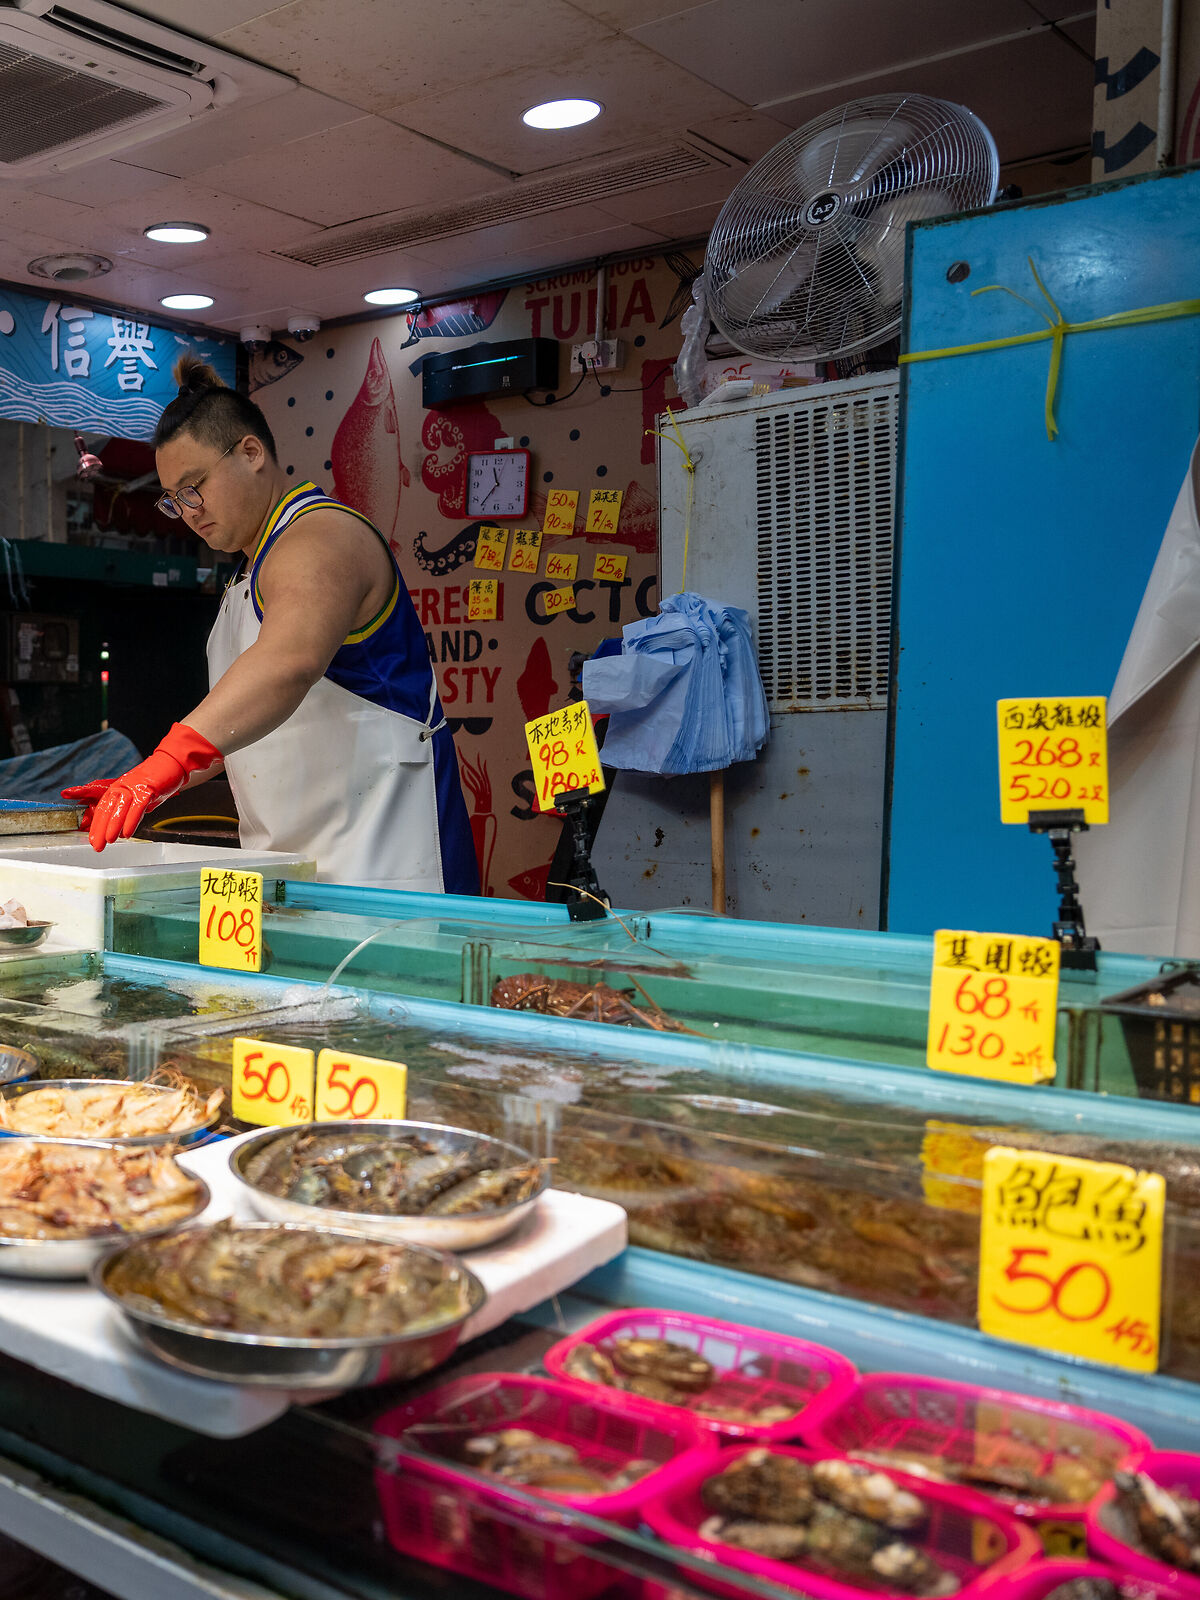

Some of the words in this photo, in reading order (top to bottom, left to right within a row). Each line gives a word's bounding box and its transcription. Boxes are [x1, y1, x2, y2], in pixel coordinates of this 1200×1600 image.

[42, 301, 158, 391] 信譽
[550, 492, 568, 506] 50
[597, 556, 616, 574] 25
[546, 593, 562, 609] 30
[539, 740, 569, 770] 98
[1010, 736, 1083, 768] 268
[543, 772, 580, 800] 180
[1008, 774, 1071, 802] 520
[206, 904, 255, 947] 108
[955, 973, 1011, 1020] 68
[937, 1022, 1005, 1060] 130
[239, 1052, 290, 1103] 50
[324, 1063, 379, 1120] 50
[995, 1164, 1147, 1258] 鮑魚
[992, 1246, 1112, 1323] 50
